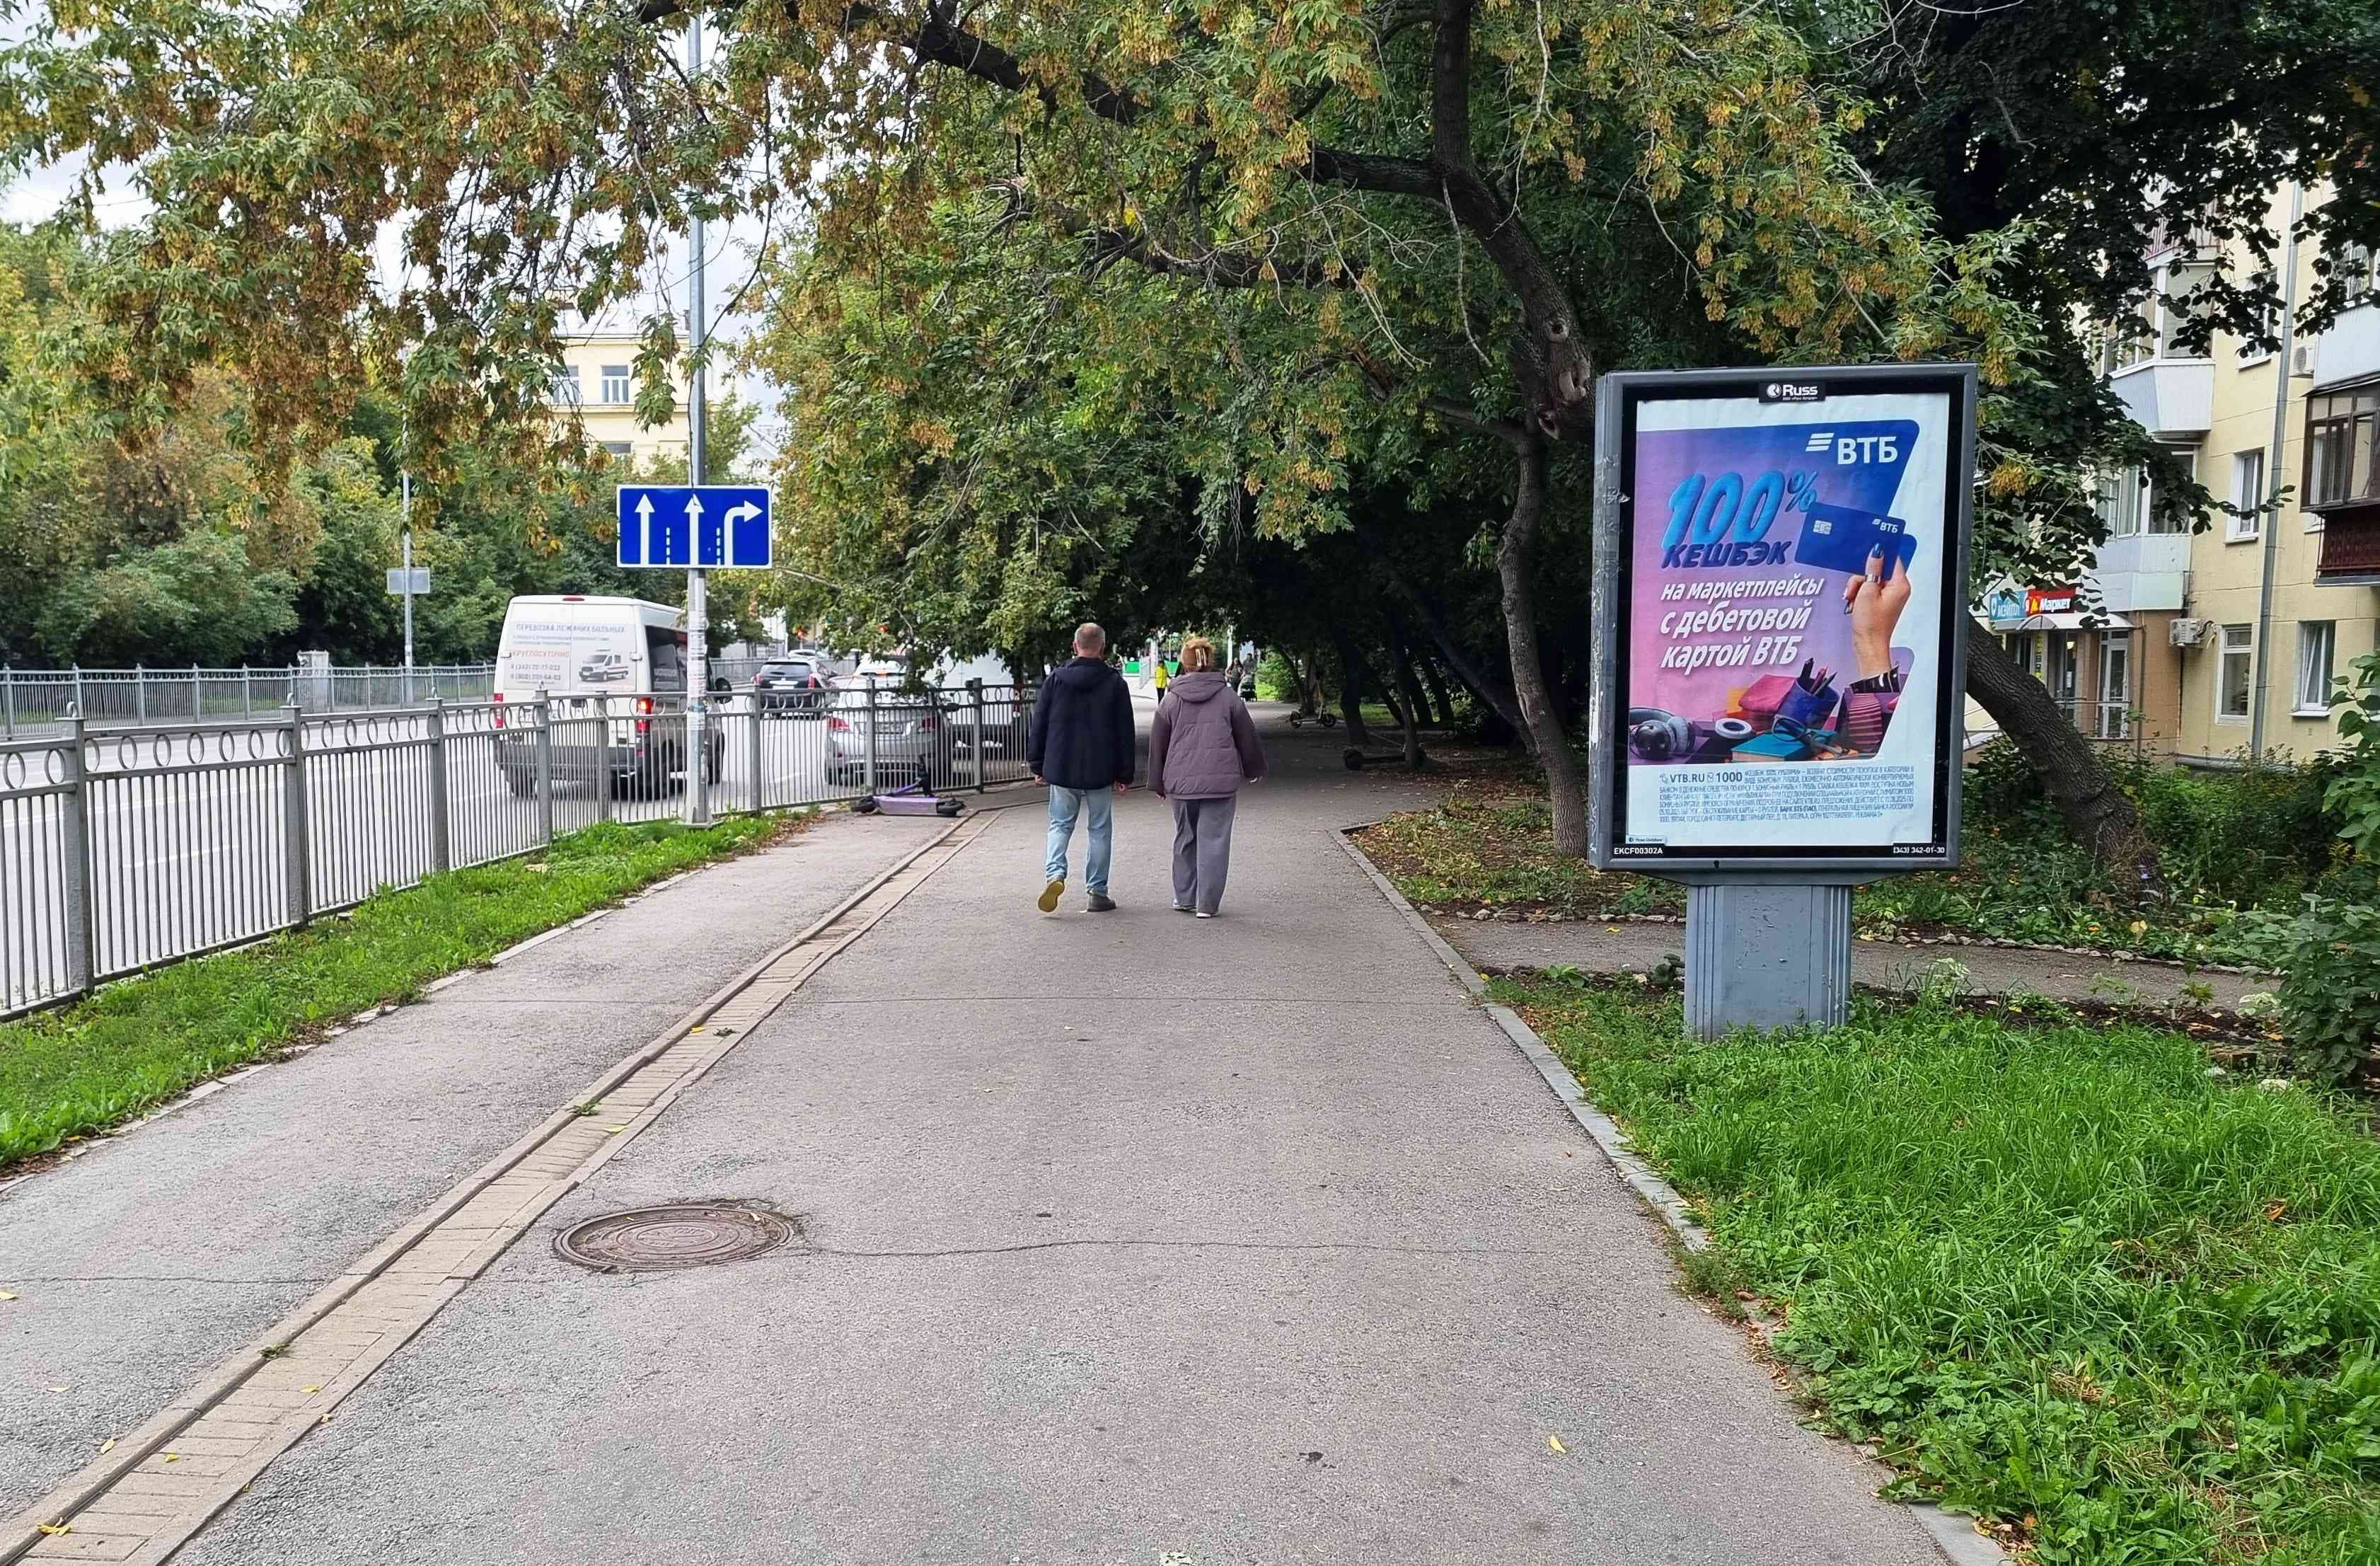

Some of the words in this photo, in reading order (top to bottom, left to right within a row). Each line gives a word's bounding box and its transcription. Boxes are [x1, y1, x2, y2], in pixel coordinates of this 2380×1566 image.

[1782, 384, 1818, 396] Russ
[1837, 436, 1898, 465] ВТБ
[1661, 470, 1819, 551] 100%
[1879, 522, 1899, 534] ВТБ
[1660, 541, 1792, 569] КЕШБЭК
[1660, 583, 1685, 600] на
[1687, 572, 1825, 604] маркетплейсы
[1660, 611, 1676, 634] с
[1672, 599, 1813, 639] дебетовой
[2040, 598, 2070, 613] Маркет
[1660, 636, 1752, 675] картой
[1751, 635, 1803, 665] ВТБ
[1670, 773, 1705, 783] VTB.RU
[1716, 772, 1743, 783] 1000
